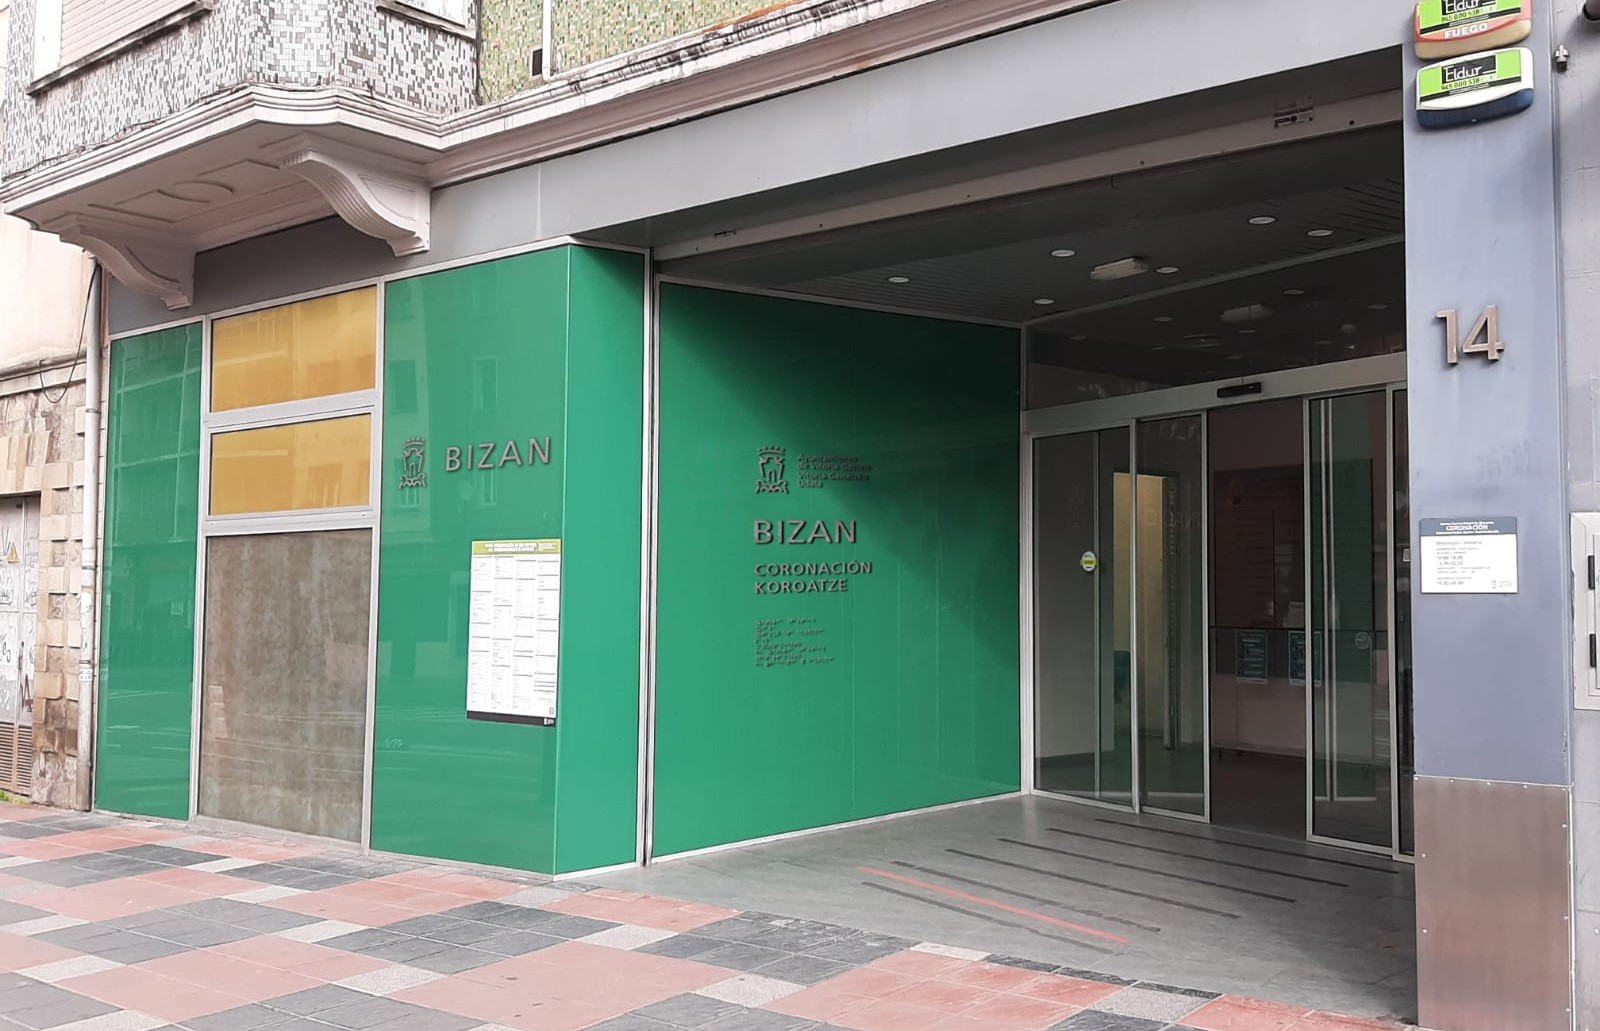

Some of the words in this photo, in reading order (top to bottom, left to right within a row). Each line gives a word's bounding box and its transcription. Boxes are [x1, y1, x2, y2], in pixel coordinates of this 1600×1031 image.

[1444, 23, 1488, 39] FUEGO
[1443, 65, 1483, 82] Eldur
[1436, 304, 1504, 364] 14
[445, 436, 551, 472] BIZAN
[797, 454, 857, 463] Ayuntamiento
[797, 480, 823, 488] Udala
[753, 519, 857, 545] BIZAN
[754, 560, 873, 577] CORONACIÓN
[754, 578, 848, 595] KOROATZE
